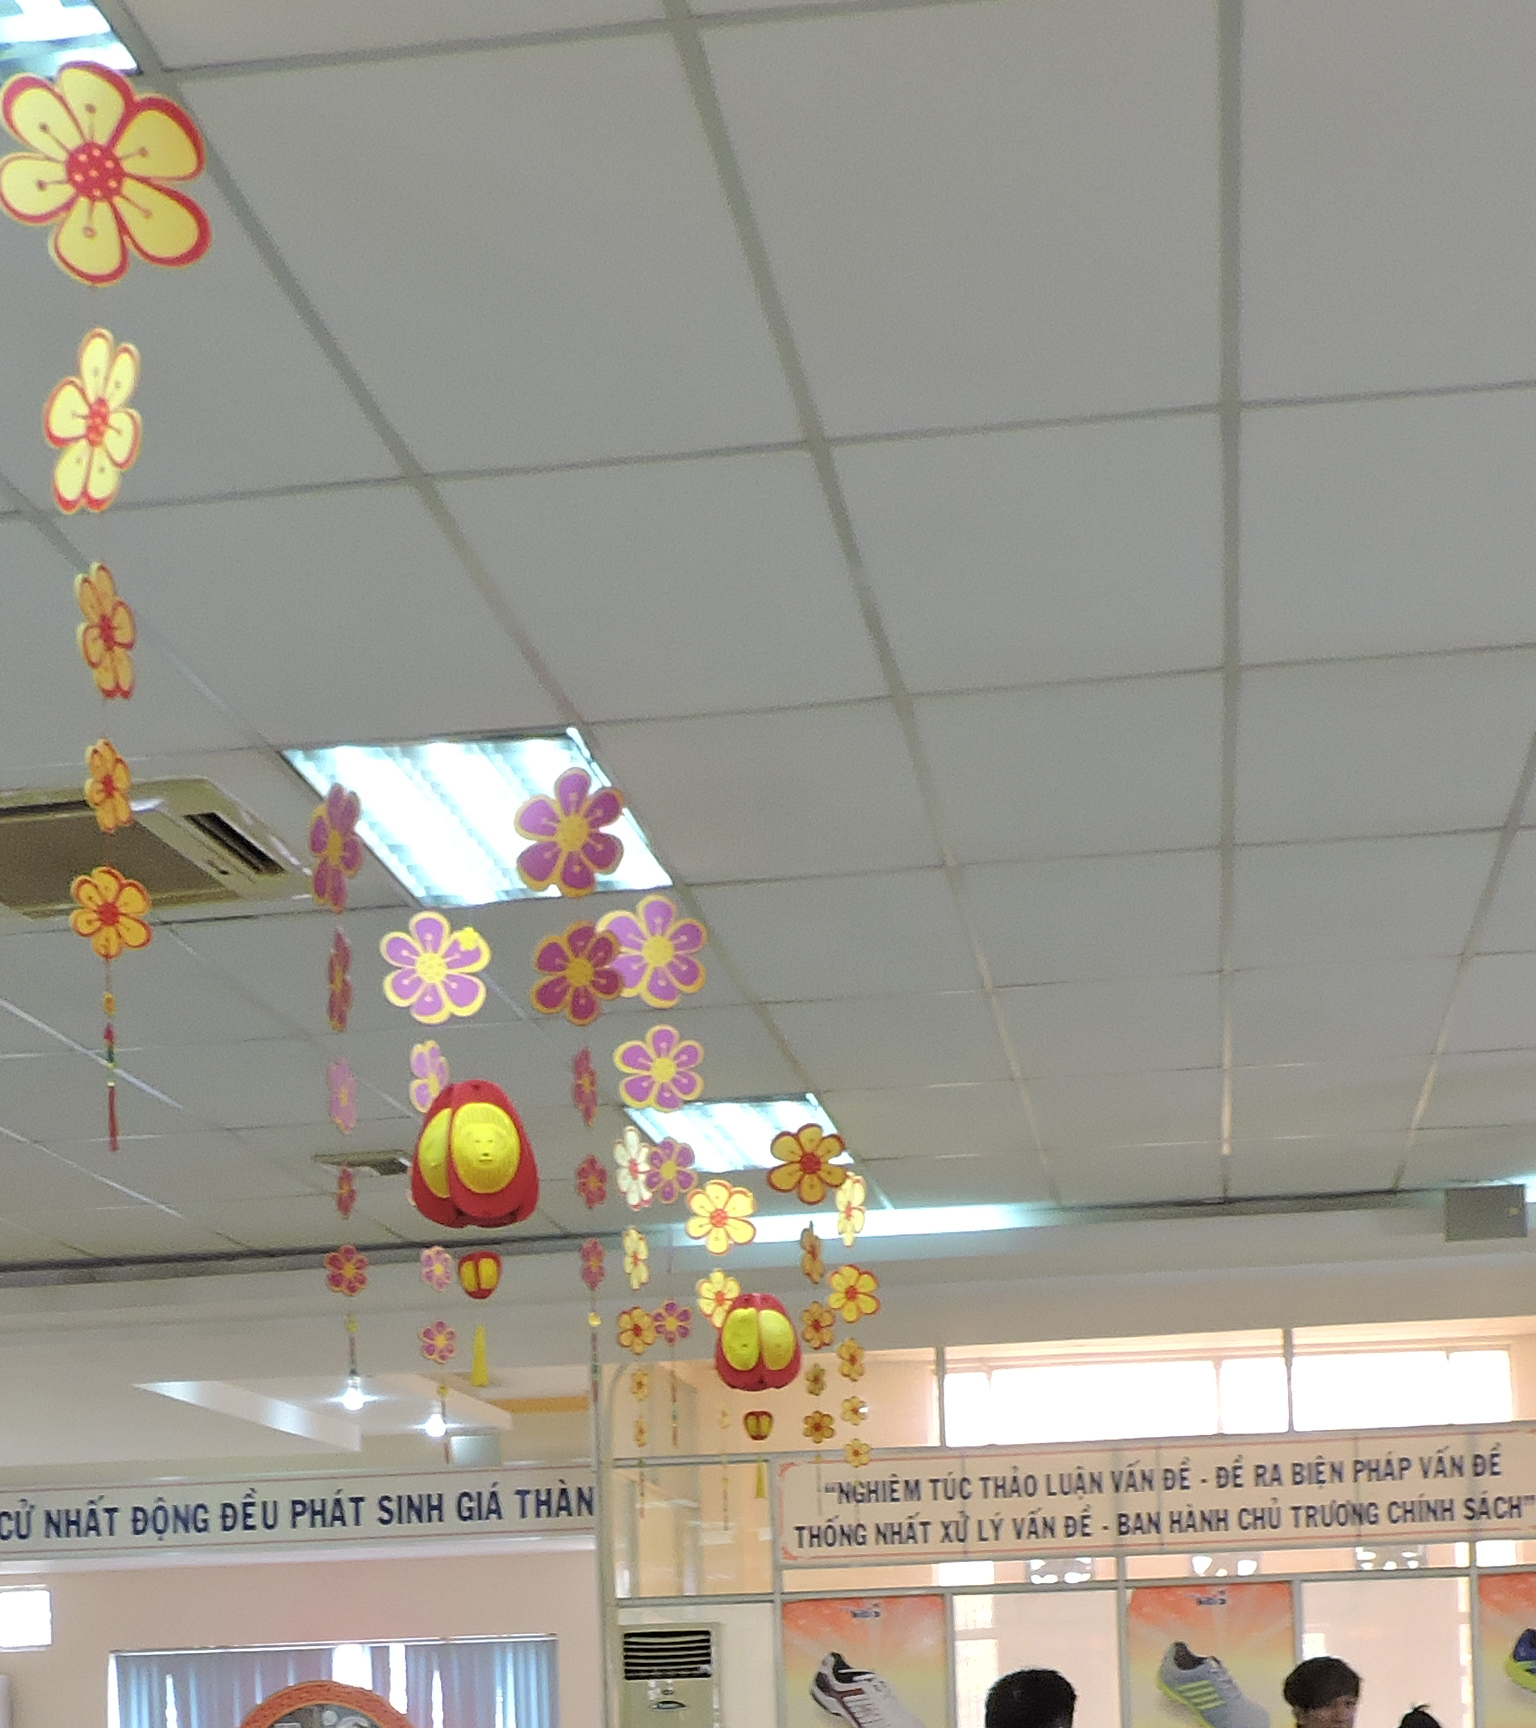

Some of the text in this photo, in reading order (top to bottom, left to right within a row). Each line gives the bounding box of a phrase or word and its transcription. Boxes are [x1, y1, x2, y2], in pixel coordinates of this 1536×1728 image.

[929, 1471, 972, 1501] TÚC
[979, 1465, 1038, 1498] THẢO
[1046, 1466, 1104, 1500] LUẬN
[1111, 1459, 1154, 1493] VẤN
[1253, 1463, 1282, 1487] RA
[1291, 1455, 1344, 1489] BIỆN
[1352, 1451, 1412, 1484] PHÁP
[1419, 1446, 1464, 1479] VẤN
[44, 1494, 120, 1539] NHẤT
[131, 1497, 210, 1542] ĐỘNG
[220, 1487, 278, 1533] ĐỀU
[290, 1487, 366, 1529] PHÁT
[377, 1492, 444, 1526] SINH
[456, 1481, 504, 1522] GIÁ
[794, 1514, 867, 1549] THỐNG
[874, 1511, 932, 1546] NHẤT
[940, 1510, 970, 1544] XỬ
[977, 1512, 1004, 1542] LÝ
[1011, 1507, 1056, 1541] VẤN
[1117, 1510, 1162, 1536] BAN
[1169, 1501, 1230, 1534] HÀNH
[1238, 1497, 1282, 1530] CHỦ
[1290, 1501, 1380, 1528] TRƯƠNG
[1387, 1493, 1455, 1523] CHÍNH
